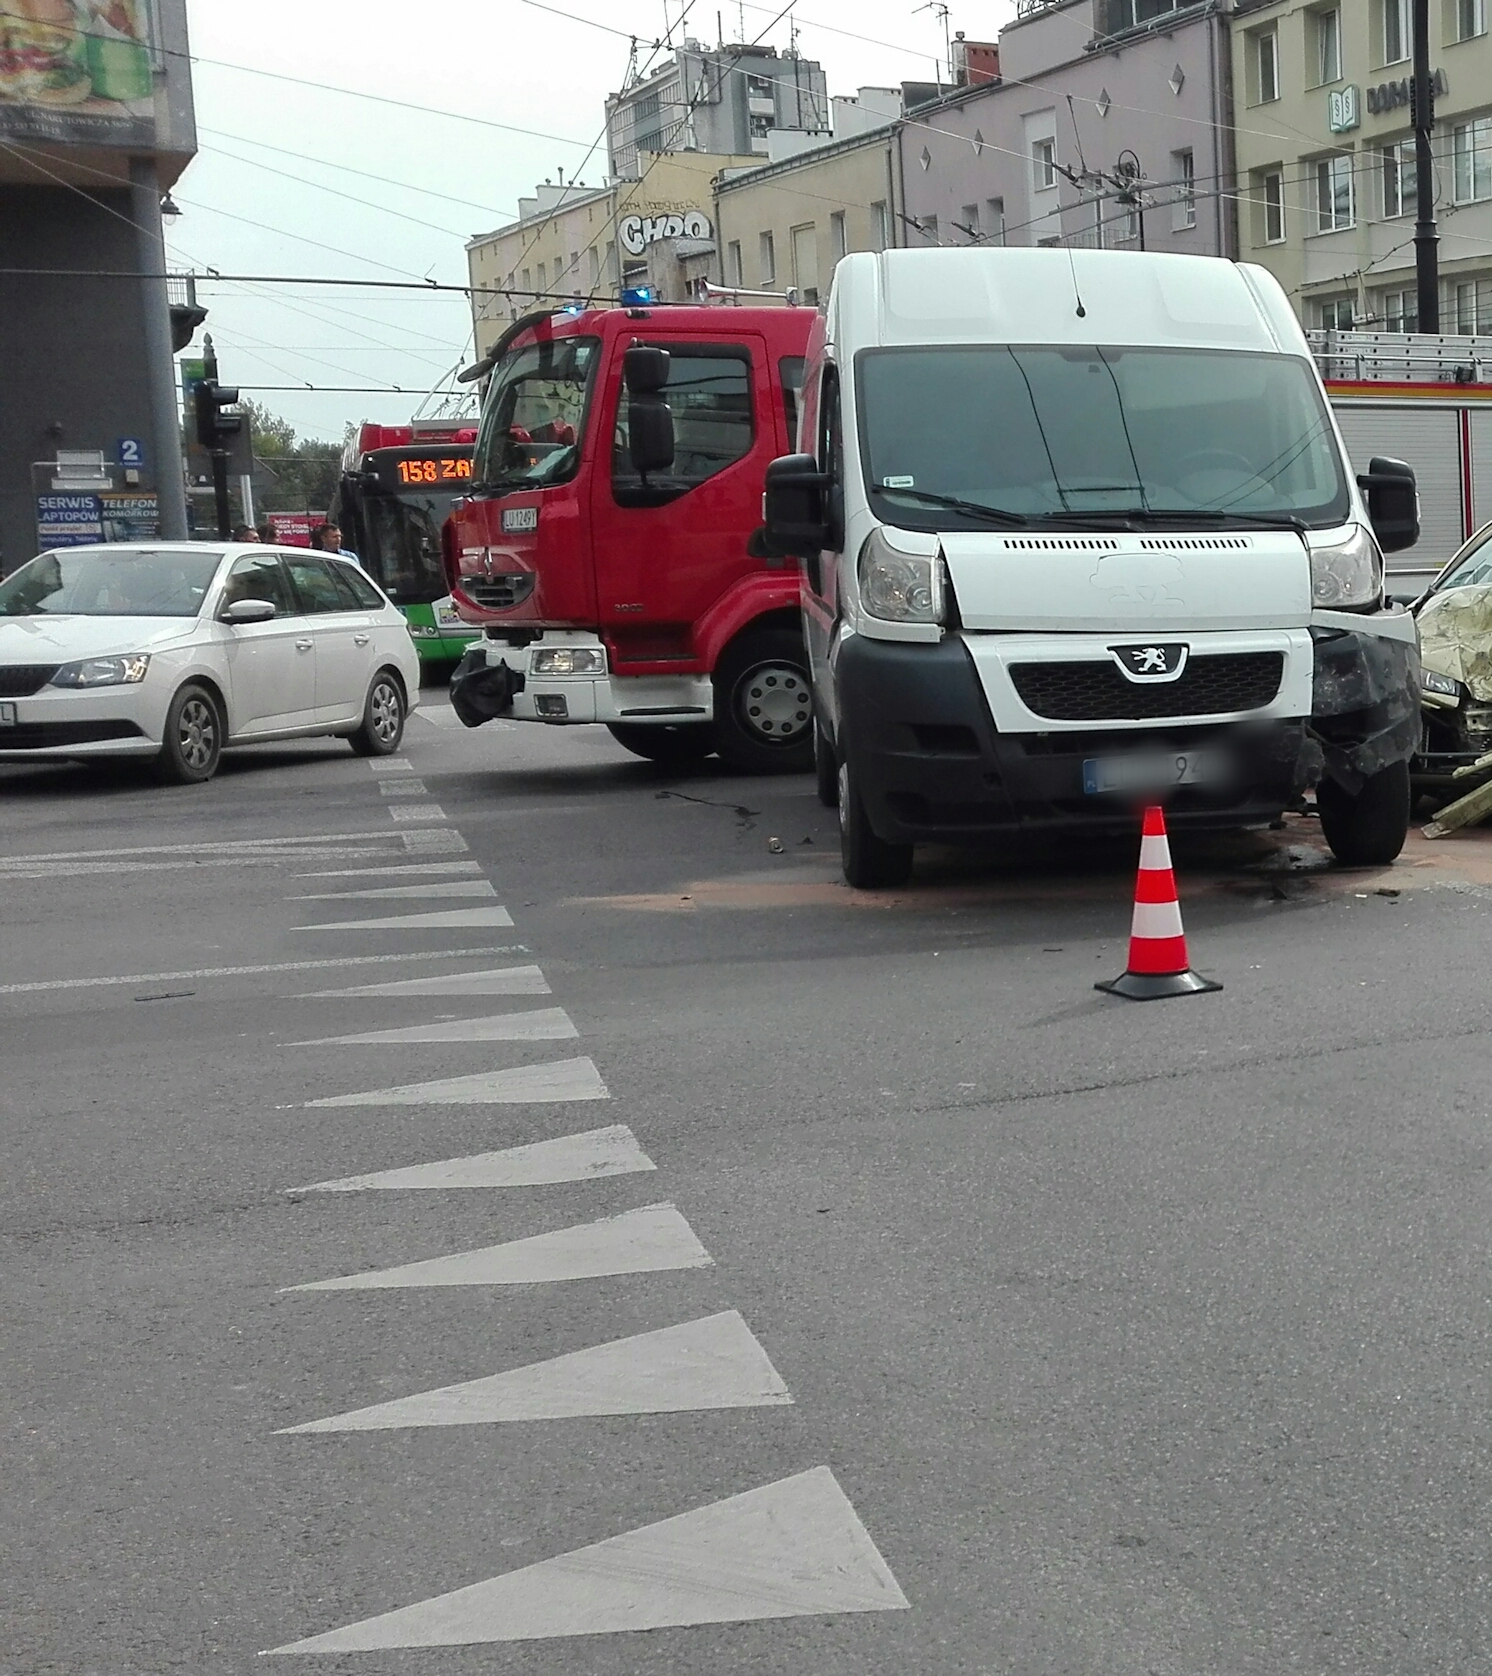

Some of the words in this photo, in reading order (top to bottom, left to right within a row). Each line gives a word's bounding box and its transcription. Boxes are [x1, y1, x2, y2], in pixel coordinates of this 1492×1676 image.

[121, 440, 138, 461] 2
[398, 460, 437, 482] 158
[38, 497, 94, 509] SERWIS
[102, 499, 157, 508] TELEFON
[505, 512, 514, 527] LU
[516, 510, 536, 527] 1249Y
